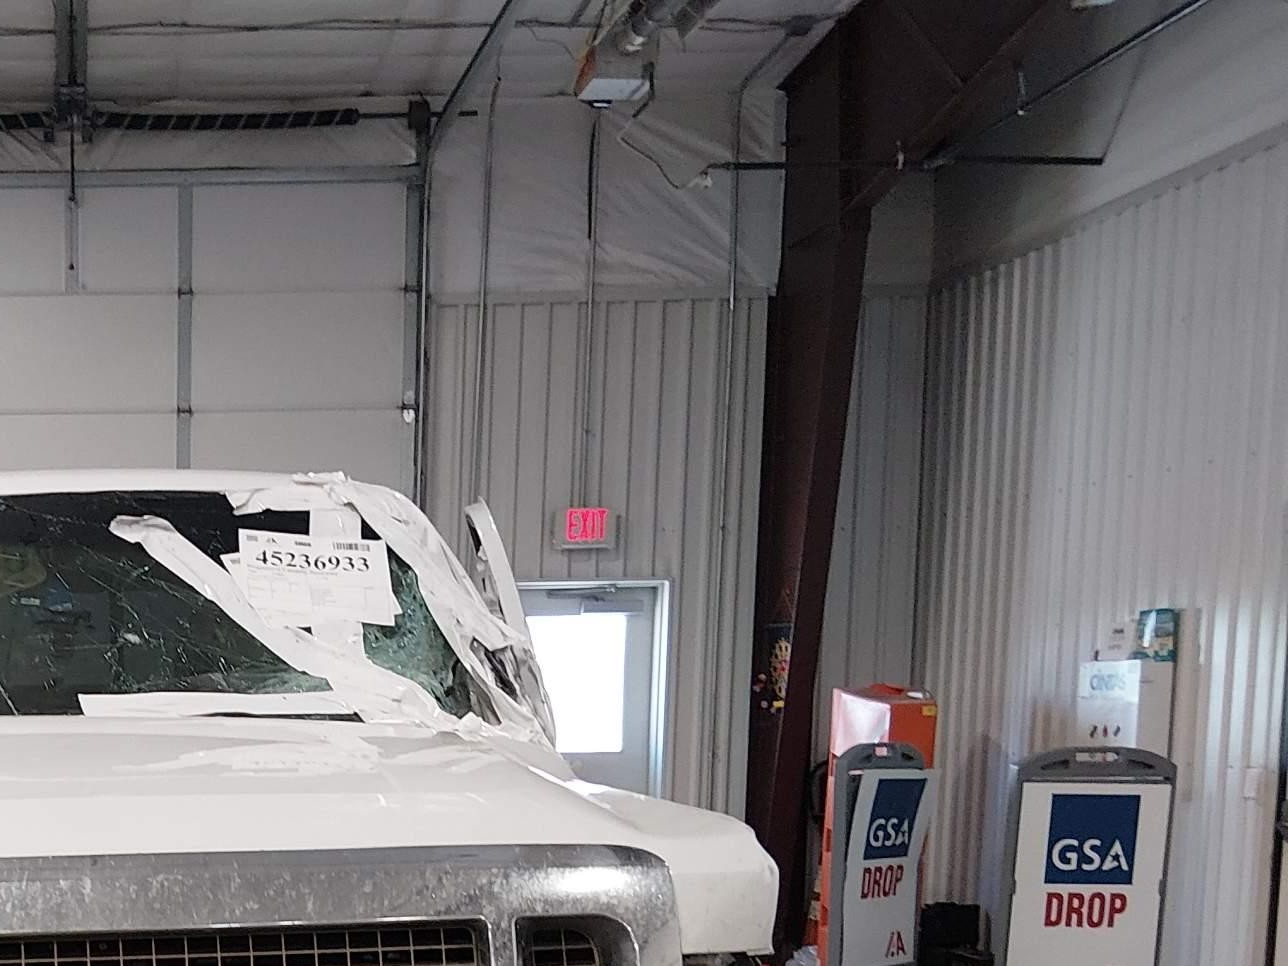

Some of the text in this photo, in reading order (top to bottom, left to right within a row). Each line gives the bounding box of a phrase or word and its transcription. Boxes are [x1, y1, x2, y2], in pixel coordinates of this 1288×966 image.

[567, 508, 608, 541] EXIT
[255, 549, 370, 573] 45236933
[868, 817, 909, 848] GSA
[1051, 838, 1129, 872] GSA
[860, 864, 905, 900] DROP
[1043, 891, 1127, 929] DROP
